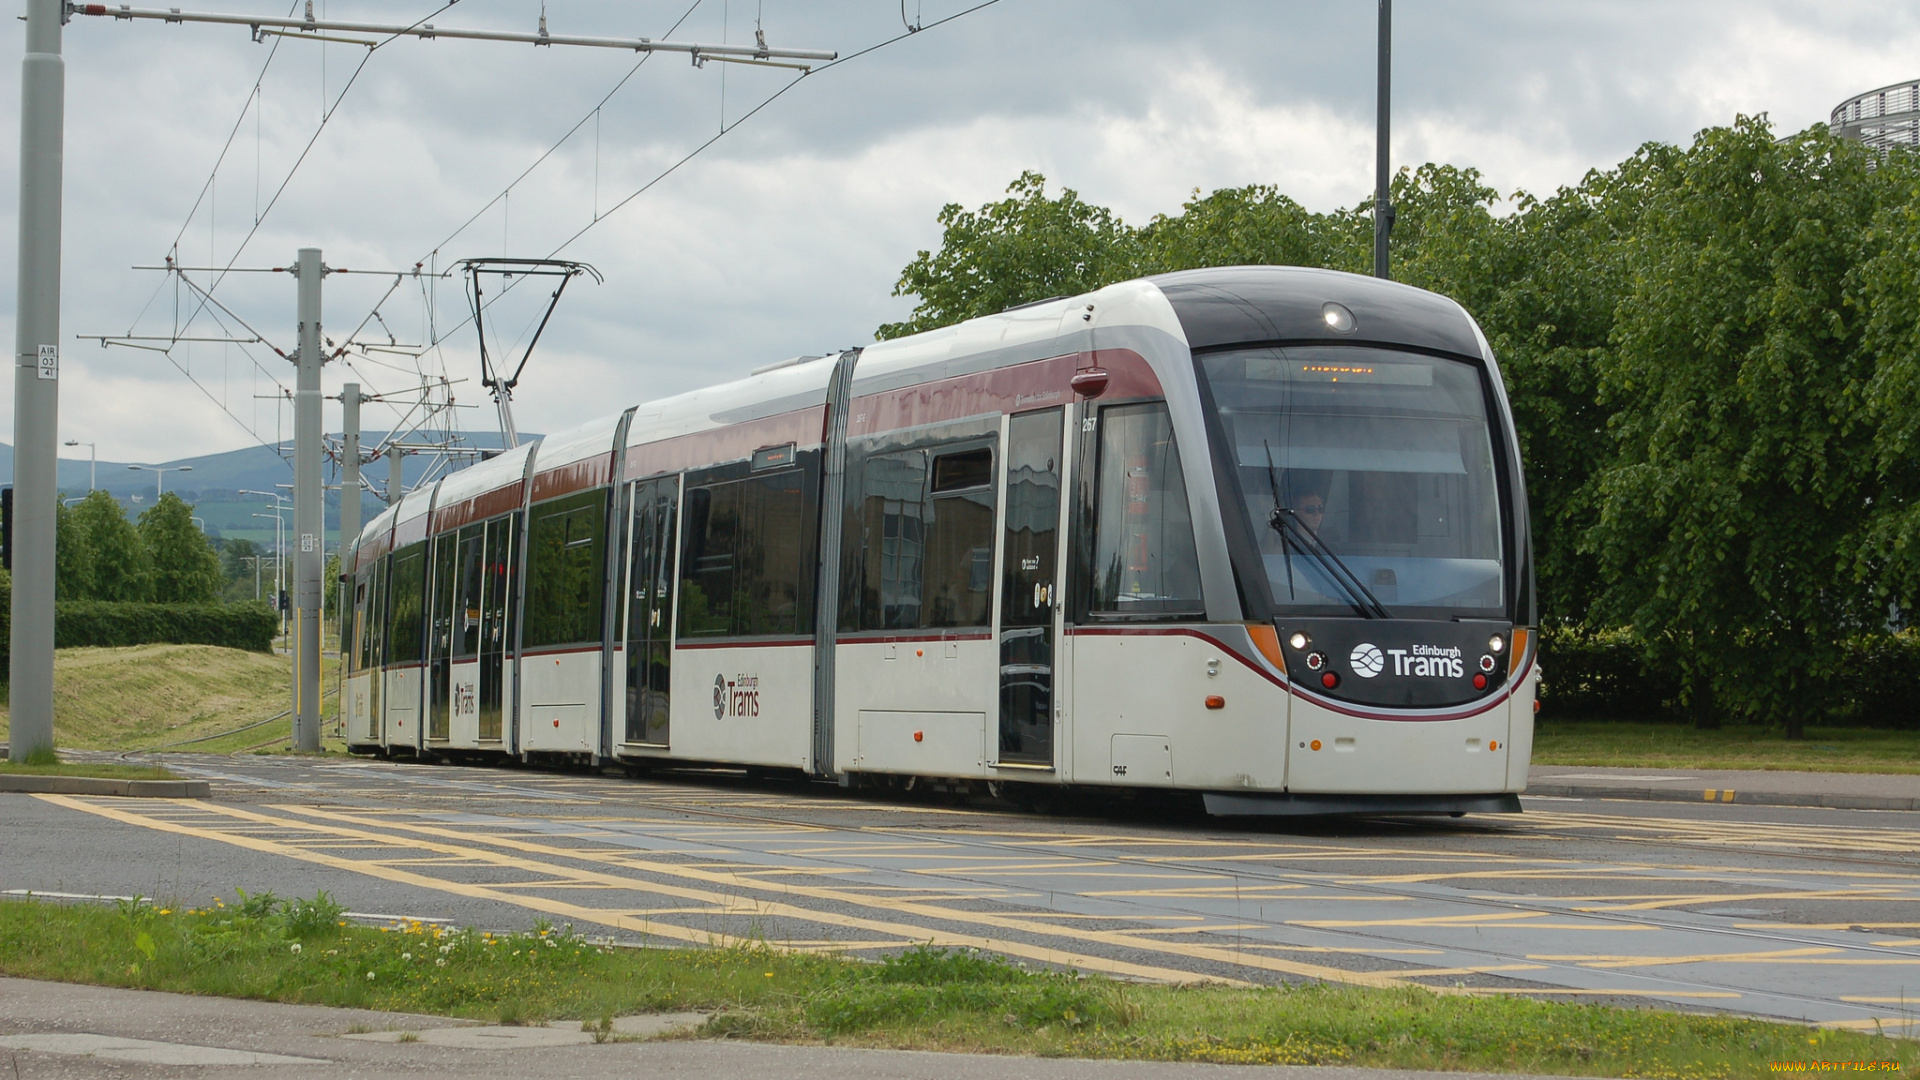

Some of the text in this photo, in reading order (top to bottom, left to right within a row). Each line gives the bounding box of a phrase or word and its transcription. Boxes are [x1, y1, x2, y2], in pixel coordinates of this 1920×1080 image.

[41, 347, 55, 357] AIR
[42, 358, 54, 366] 03
[1082, 417, 1097, 432] 267
[1412, 645, 1461, 658] Edinburgh
[1387, 649, 1464, 678] Trams
[738, 673, 758, 690] Edinburgh
[728, 681, 759, 717] Trams
